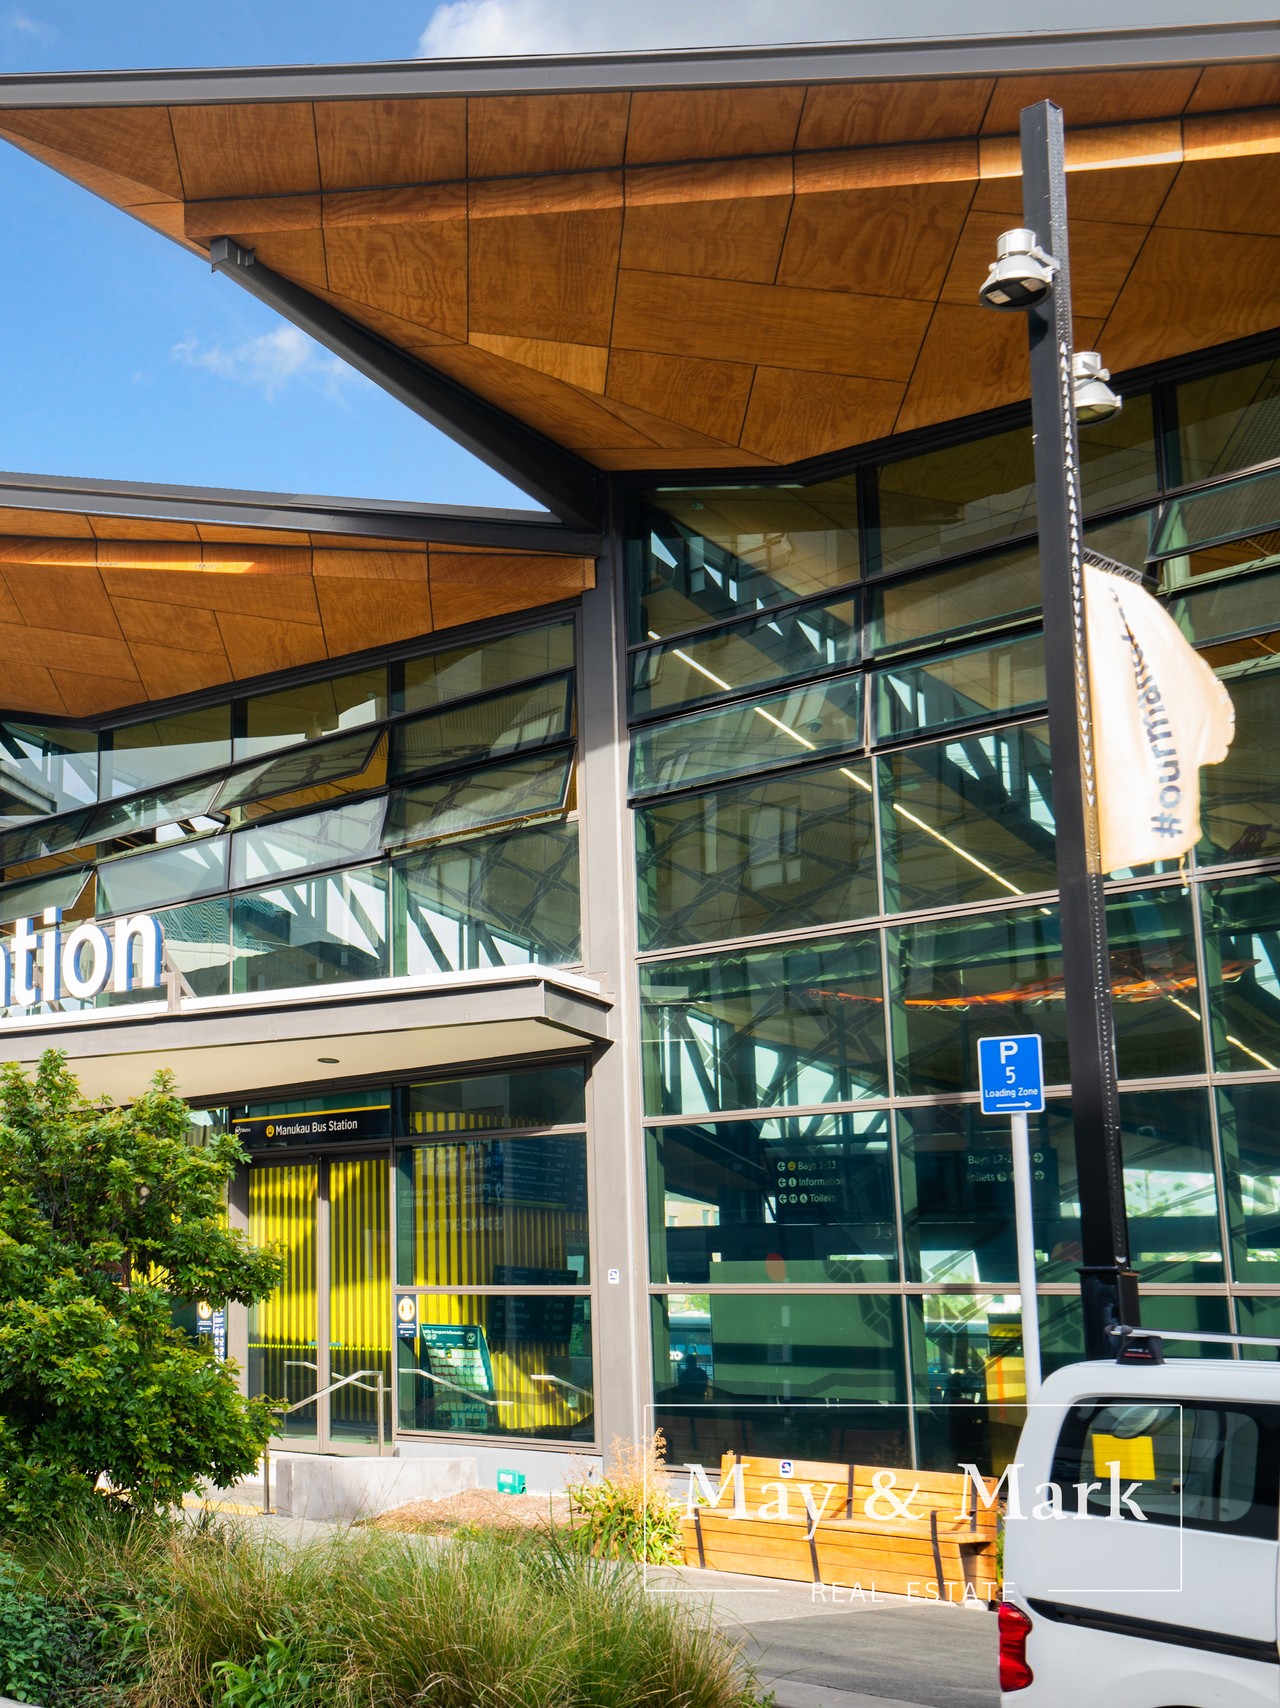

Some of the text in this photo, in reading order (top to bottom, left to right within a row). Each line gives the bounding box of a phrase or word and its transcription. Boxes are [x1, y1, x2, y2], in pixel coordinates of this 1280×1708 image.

[1000, 1041, 1019, 1064] P
[1005, 1066, 1016, 1084] 5
[985, 1087, 1039, 1098] Loading Zone
[275, 1119, 358, 1136] Manukau Bus Station
[798, 1177, 846, 1187] Information
